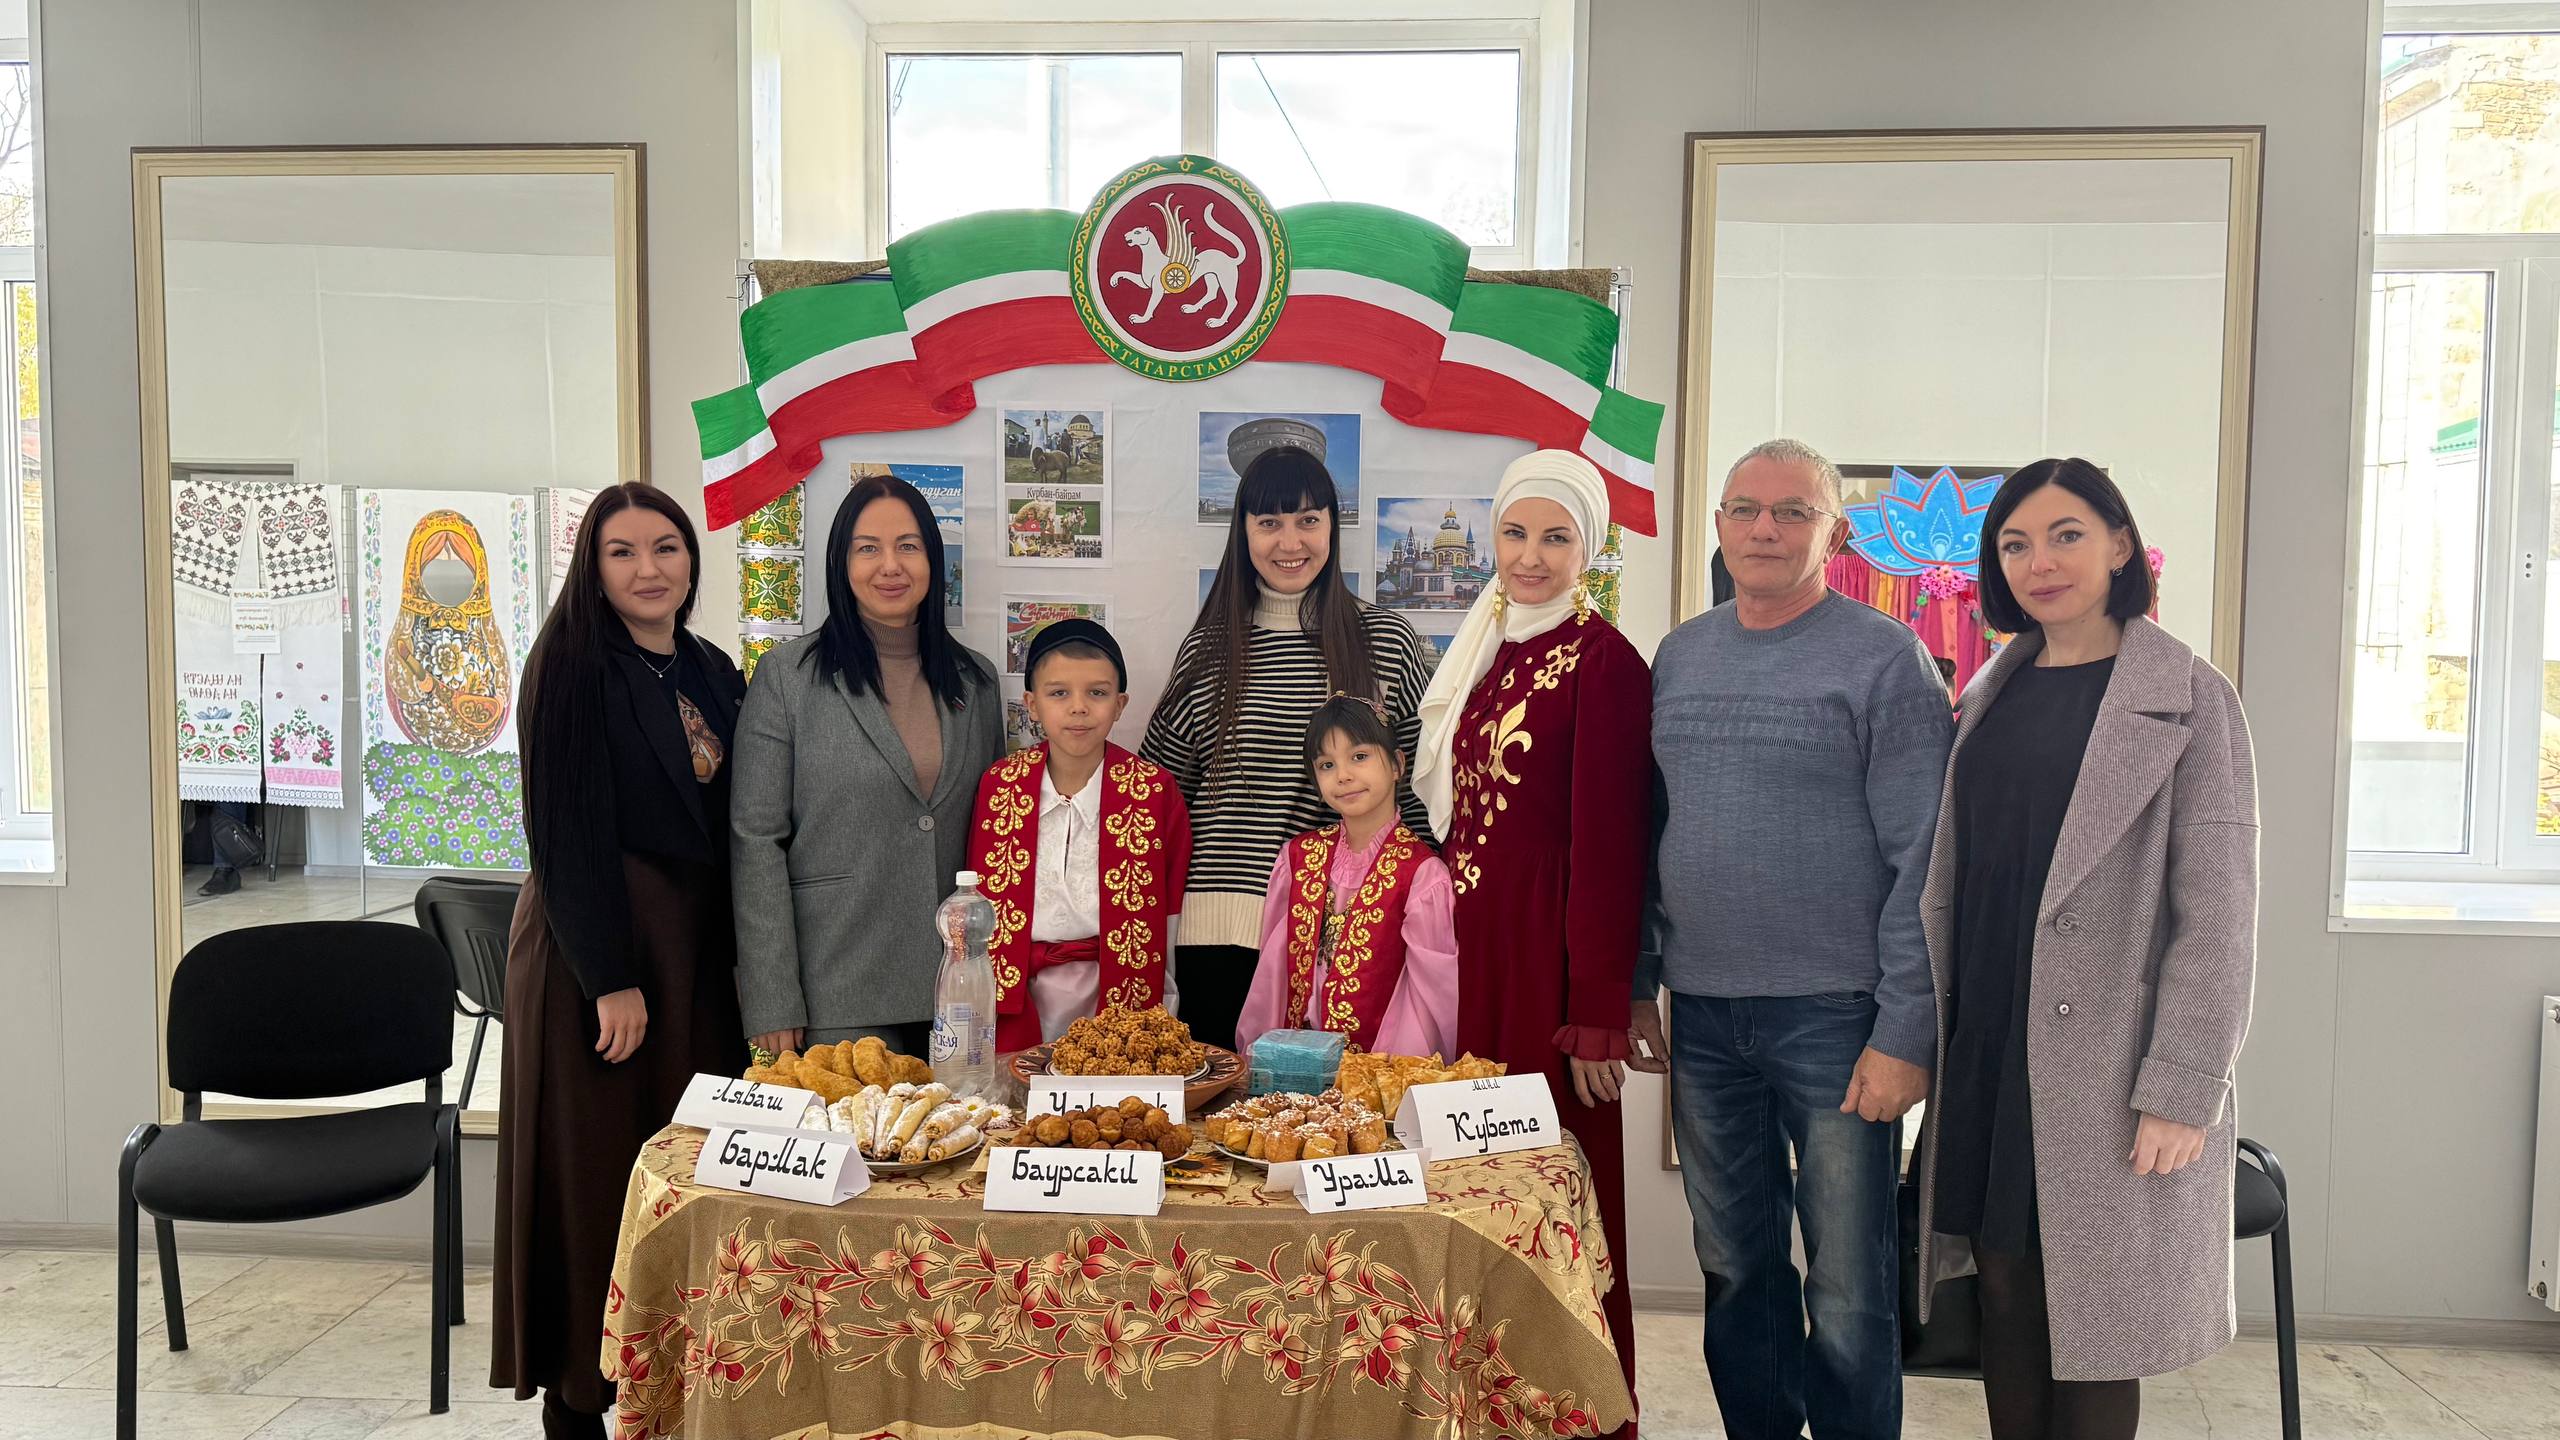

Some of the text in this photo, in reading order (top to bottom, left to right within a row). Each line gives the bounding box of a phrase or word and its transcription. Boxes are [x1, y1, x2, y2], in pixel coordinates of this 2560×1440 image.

[1119, 350, 1232, 377] ТАТАРСТАН
[1027, 487, 1081, 500] Курбан-байрам
[712, 1078, 783, 1111] Ляваш
[1446, 1108, 1540, 1153] Кубете
[1012, 1149, 1138, 1197] Баурсаки
